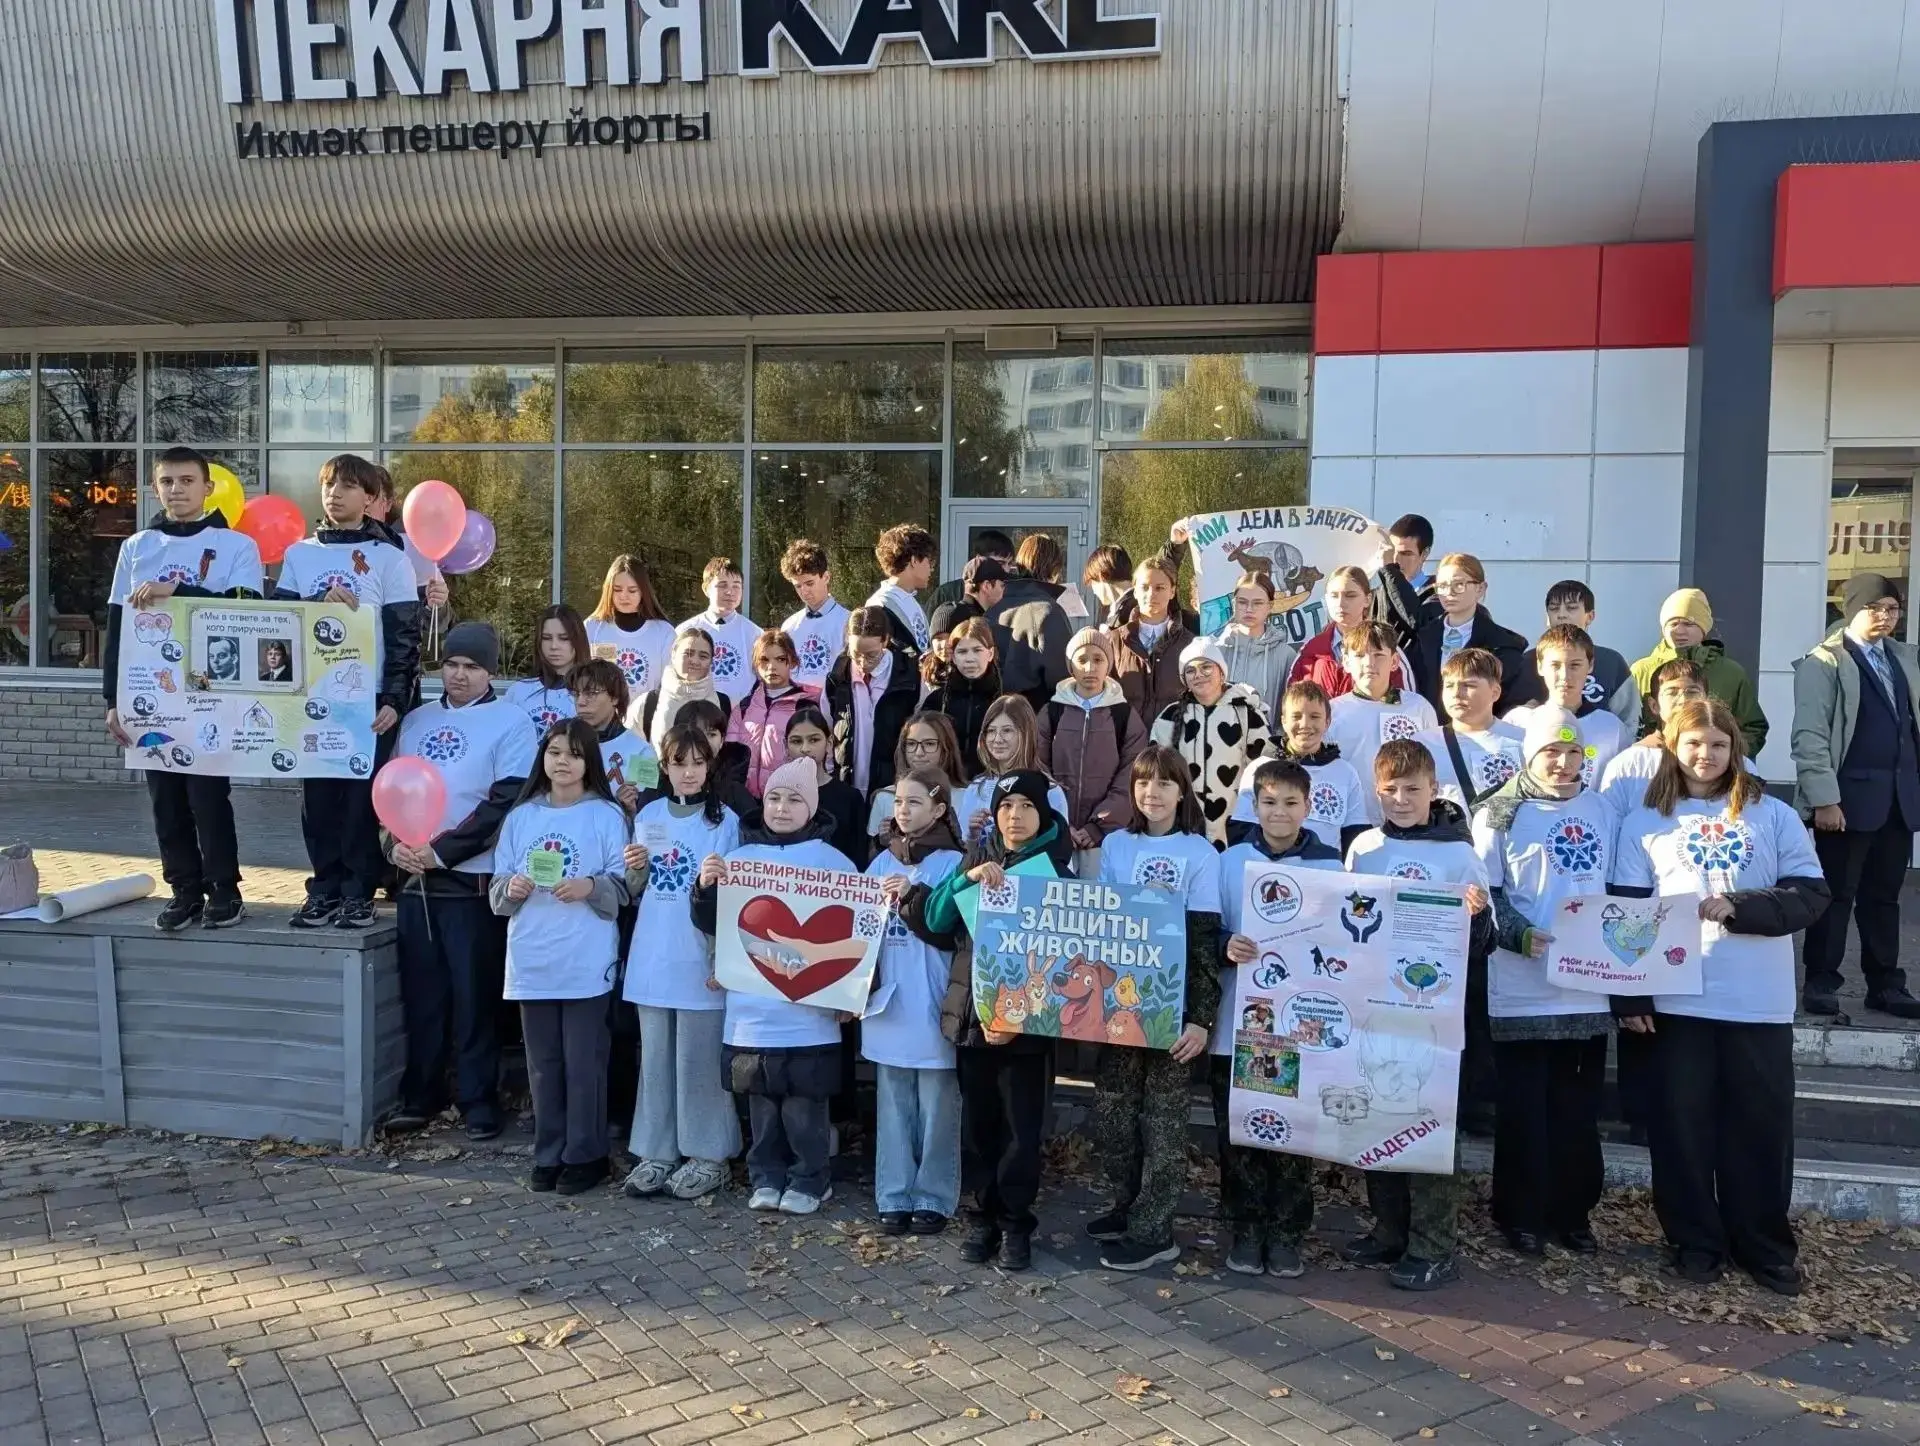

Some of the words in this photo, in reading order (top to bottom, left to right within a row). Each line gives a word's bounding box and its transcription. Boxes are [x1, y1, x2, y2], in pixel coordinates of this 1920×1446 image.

[215, 0, 705, 104] ПЕКАРНЯ
[236, 120, 370, 161] Икмәк
[565, 105, 712, 155] йорты
[1237, 509, 1284, 532] ДЕЛА
[1288, 508, 1301, 528] В
[1304, 508, 1369, 535] ЗАЩИТУ
[206, 624, 225, 632] кого
[227, 625, 280, 635] приручили»
[274, 616, 291, 625] тех,
[719, 874, 790, 894] ЗАЩИТЫ
[793, 882, 889, 906] ЖИВОТНЫХ
[730, 860, 833, 884] ВСЕМИРНЫЙ
[836, 873, 882, 890] ДЕНЬ
[1041, 881, 1122, 911] ДЕНЬ
[1019, 906, 1149, 941] ЗАЩИТЫ
[997, 930, 1164, 969] ЖИВОТНЫХ
[1565, 966, 1600, 979] ЗАЩИТУ
[1585, 960, 1611, 970] ДЕЛА
[1354, 1118, 1441, 1168] «КАДЕТЫ»
